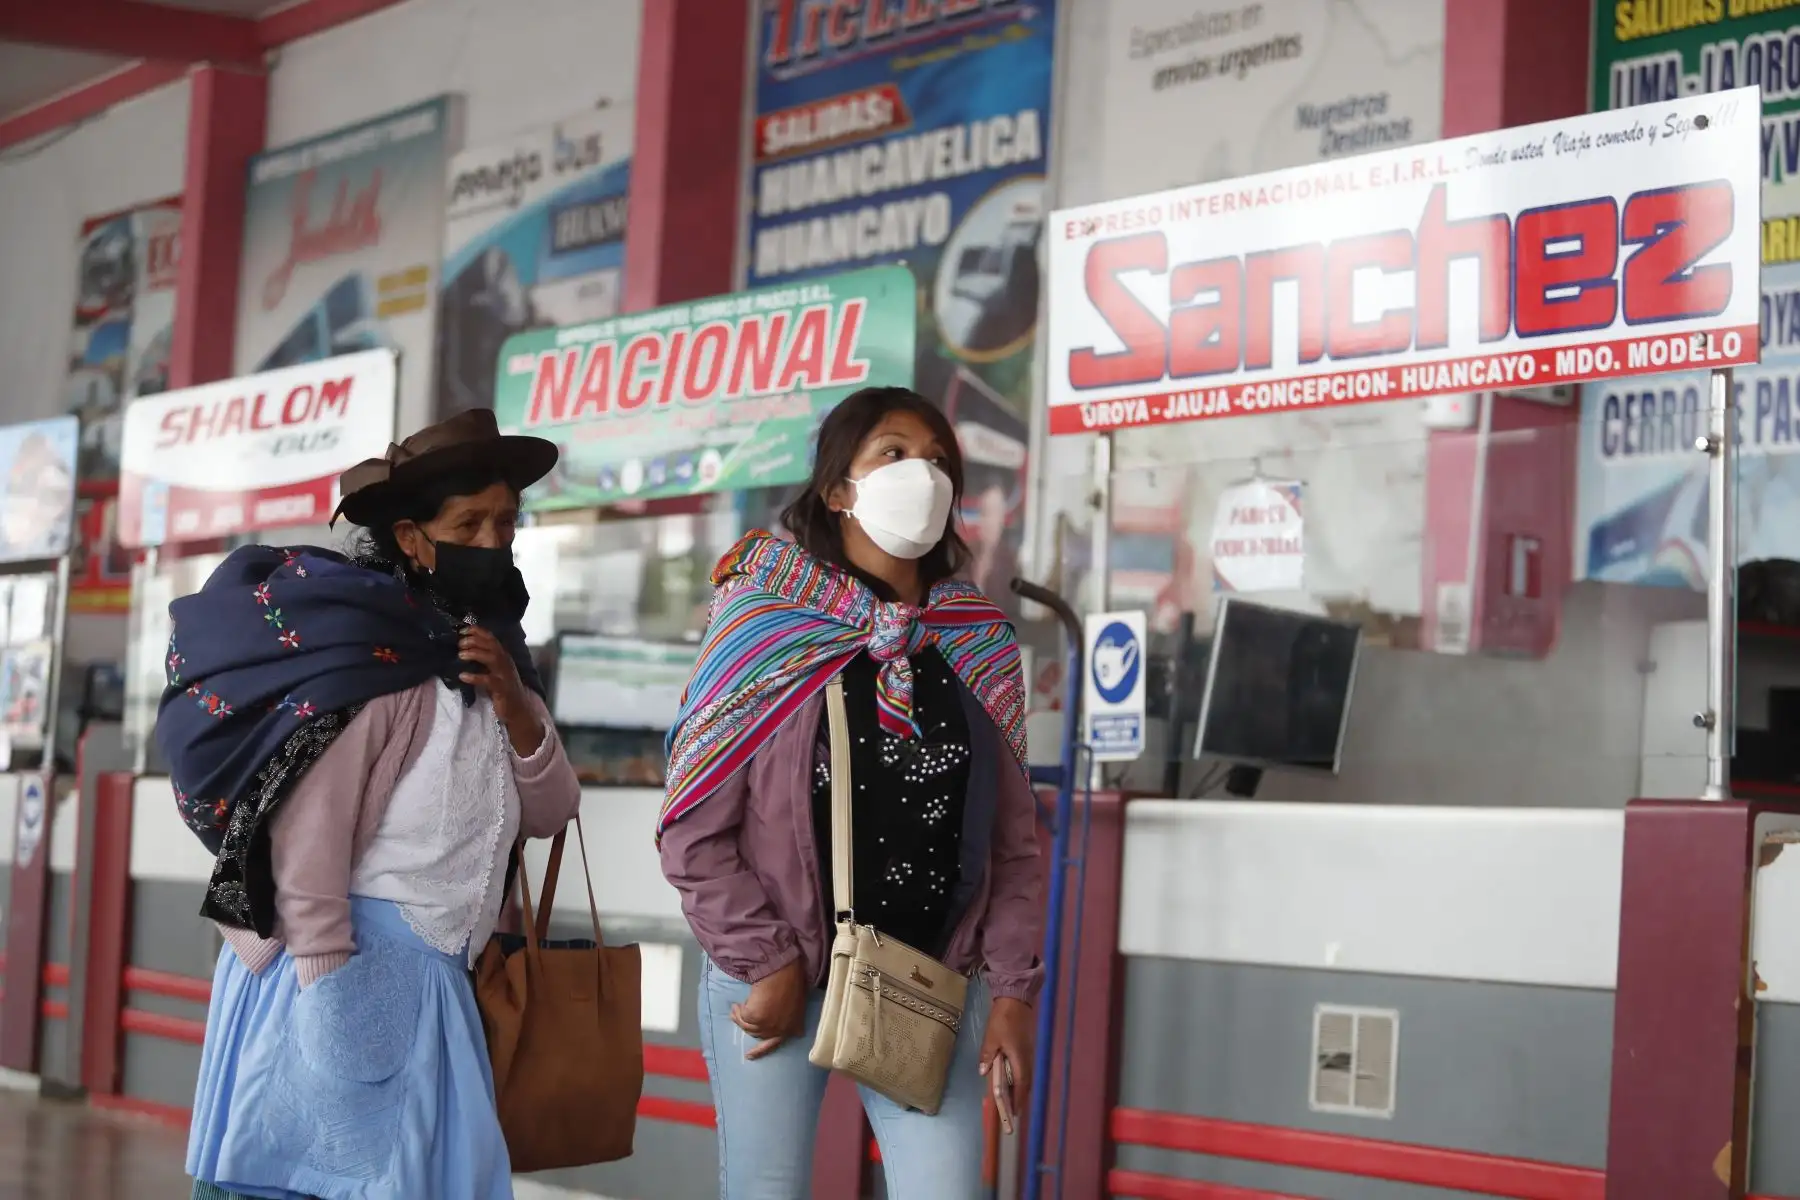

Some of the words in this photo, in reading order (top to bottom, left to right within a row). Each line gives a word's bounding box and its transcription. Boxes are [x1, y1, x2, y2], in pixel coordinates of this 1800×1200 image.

[1296, 91, 1390, 130] Nuestros
[1510, 137, 1546, 161] usted
[1552, 130, 1592, 160] Viaja
[1595, 120, 1645, 148] comodo
[1648, 125, 1659, 146] y
[759, 108, 1042, 217] HUANCAVELICA
[1065, 205, 1164, 241] EXPRESO
[1169, 171, 1361, 223] INTERNACIONAL
[1369, 153, 1459, 188] E.I.R.L.
[754, 191, 951, 278] HUANCAYO
[1068, 177, 1735, 391] Sanchez
[527, 300, 868, 425] NACIONAL
[1080, 398, 1150, 428] OROYA
[1163, 386, 1231, 420] JAUJA
[1401, 354, 1536, 393] HUANCAYO
[1555, 346, 1622, 377] MDO.
[1627, 331, 1742, 369] MODELO
[155, 374, 355, 450] SHALOM
[1602, 386, 1700, 458] CERRO
